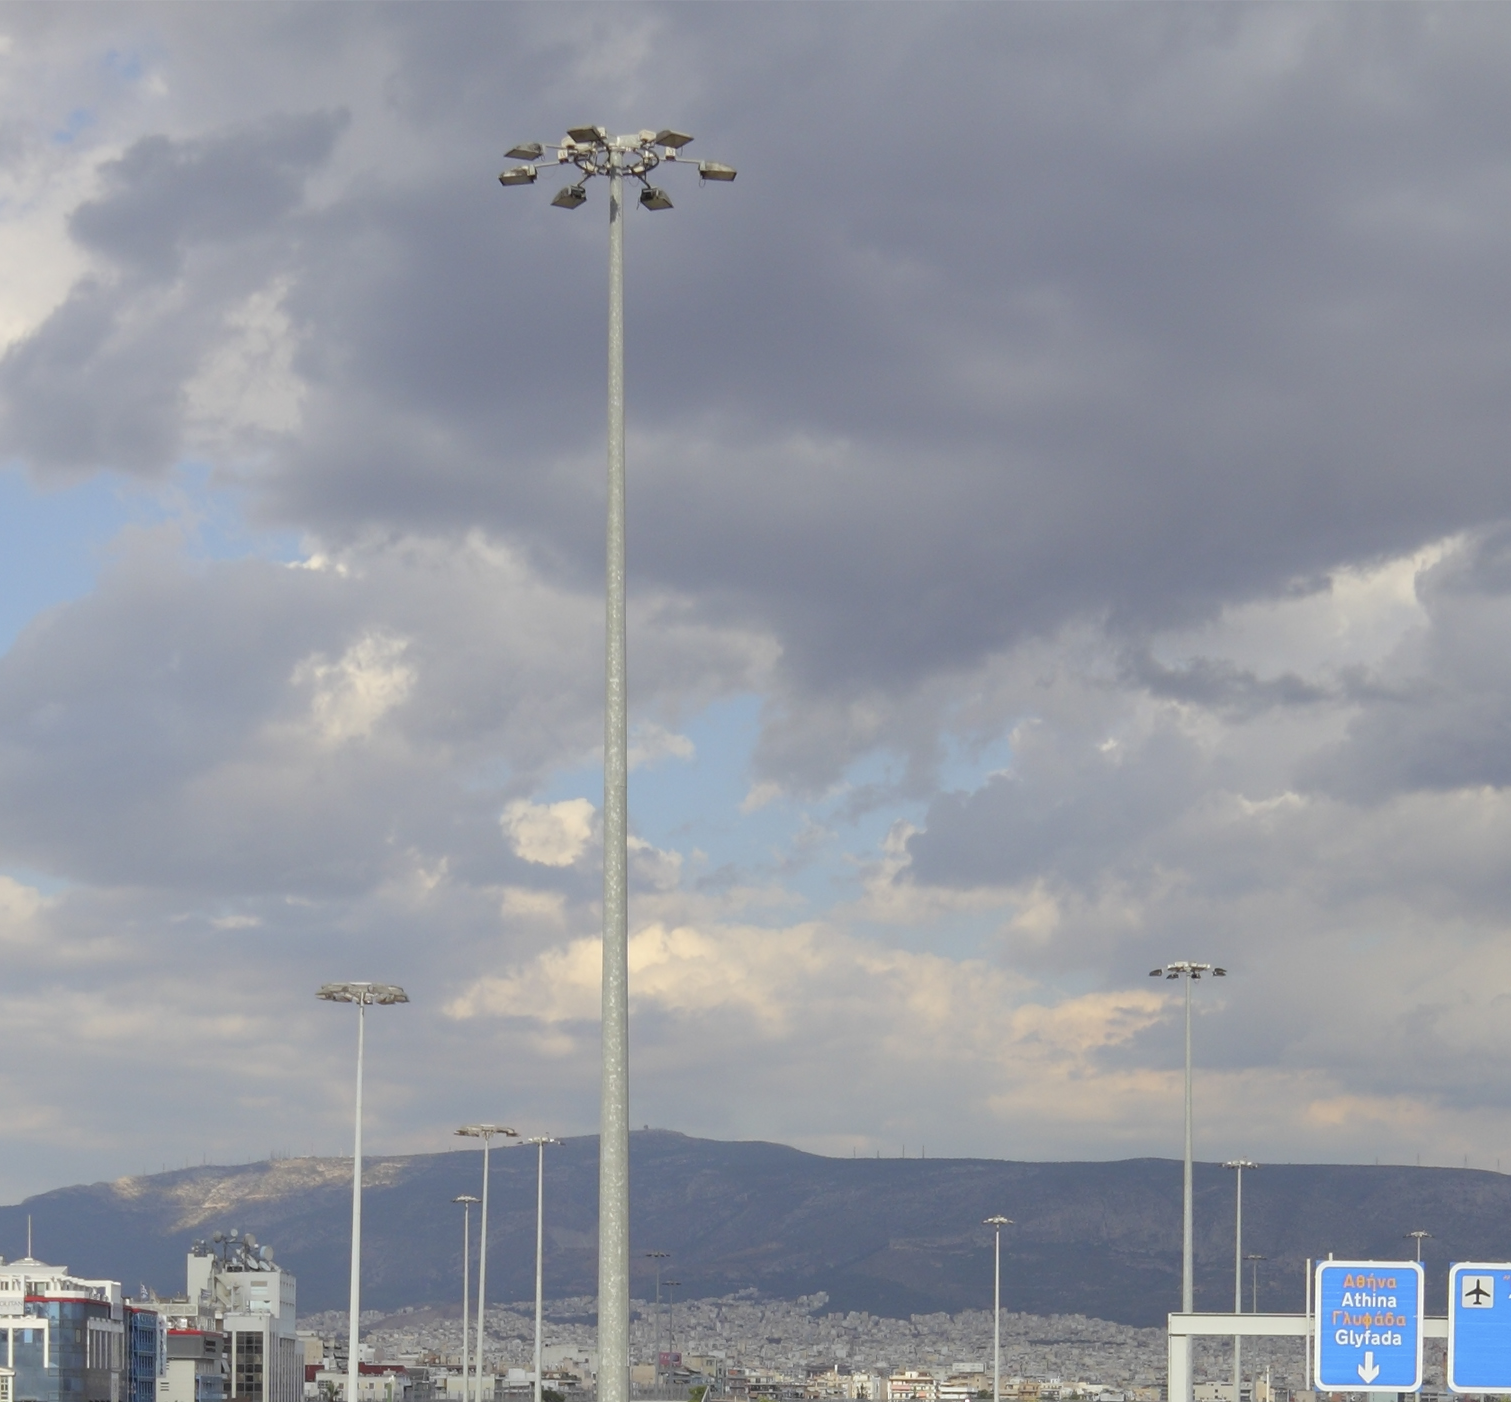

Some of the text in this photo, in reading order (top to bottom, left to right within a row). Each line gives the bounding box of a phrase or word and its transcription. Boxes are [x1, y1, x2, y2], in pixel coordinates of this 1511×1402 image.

[1343, 1273, 1397, 1291] Αθήνα
[1342, 1292, 1397, 1307] Athina
[1332, 1310, 1406, 1329] Γλυφάδα
[1335, 1329, 1402, 1348] Glyfada
